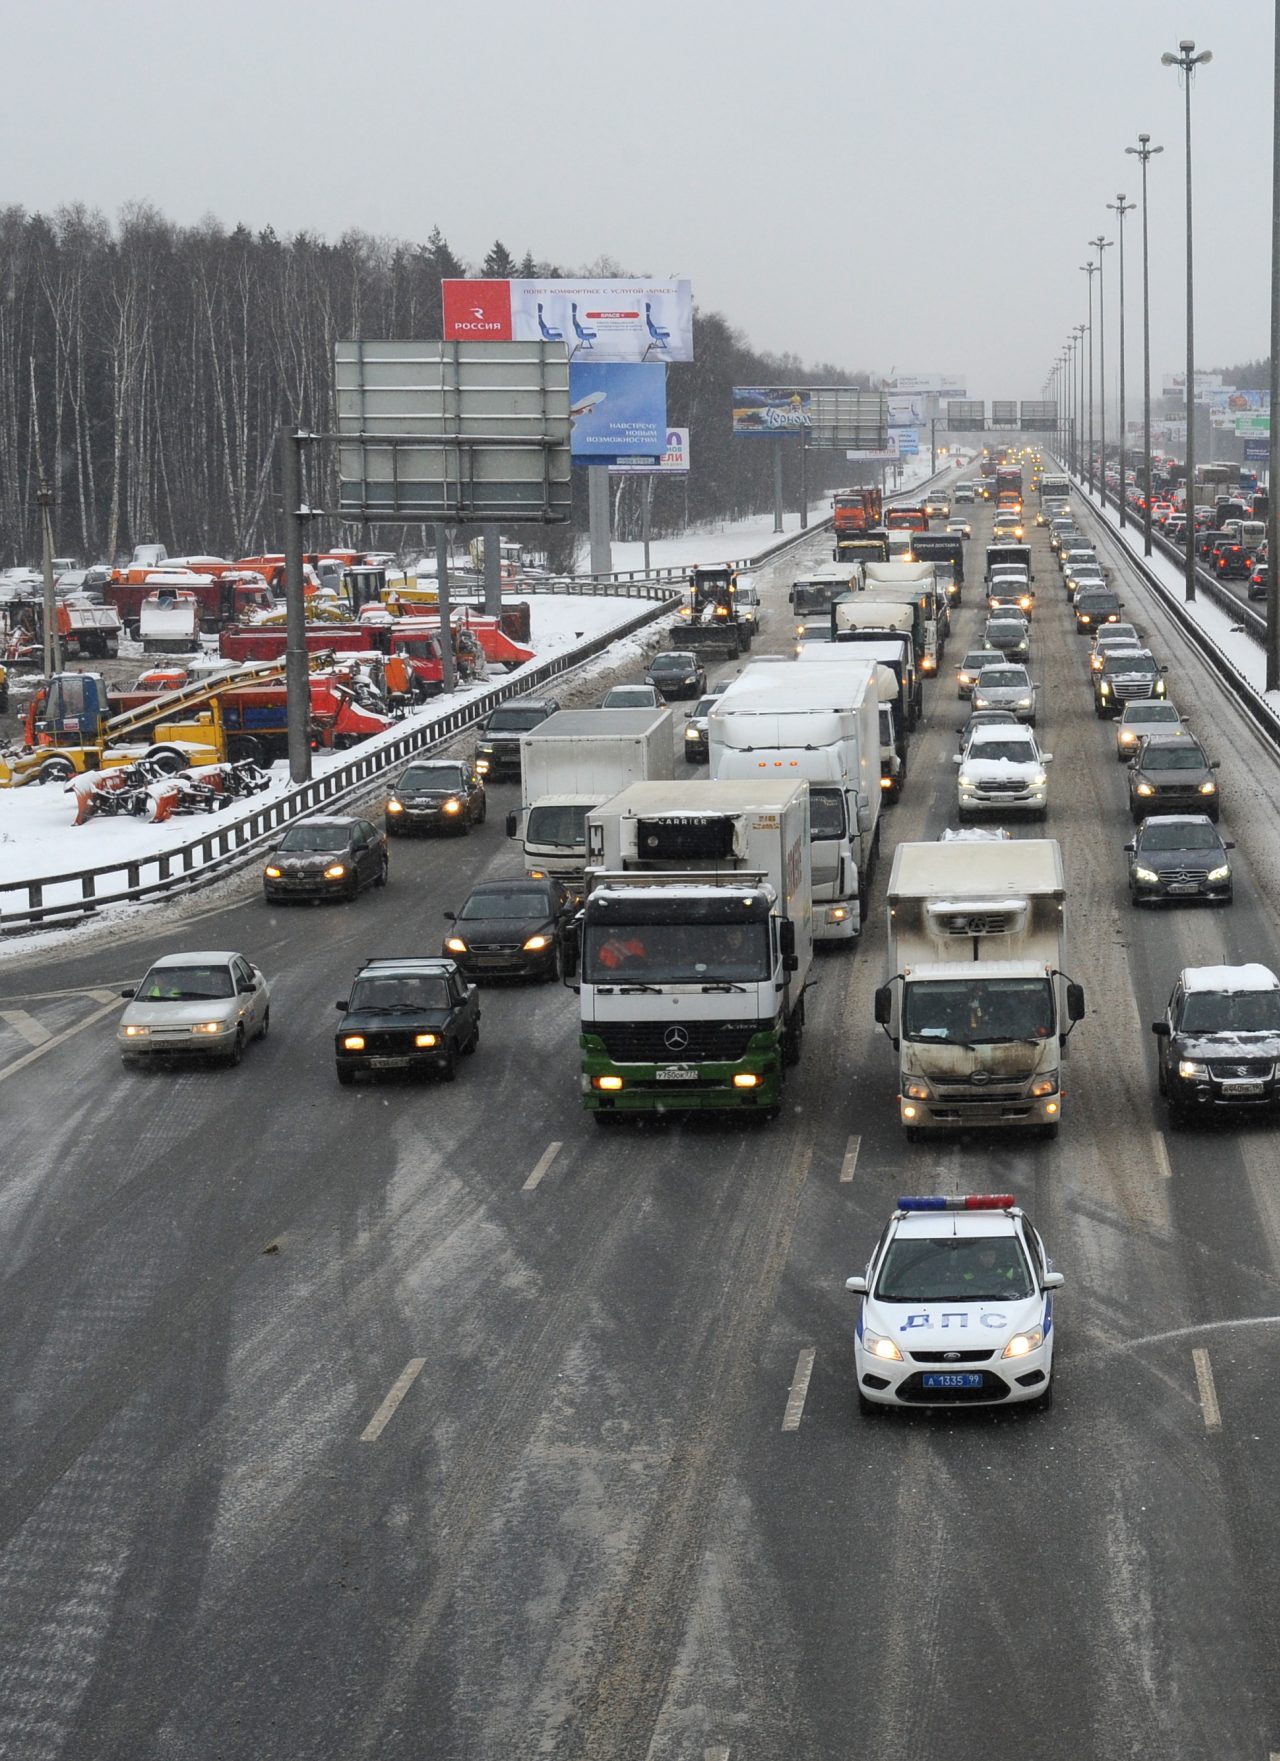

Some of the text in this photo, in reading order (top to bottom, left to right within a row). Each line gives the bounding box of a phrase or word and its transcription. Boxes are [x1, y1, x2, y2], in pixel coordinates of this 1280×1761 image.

[455, 322, 501, 330] РОССИЯ
[900, 1313, 1007, 1331] ДПС
[939, 1375, 963, 1385] 1335
[969, 1375, 979, 1383] 99
